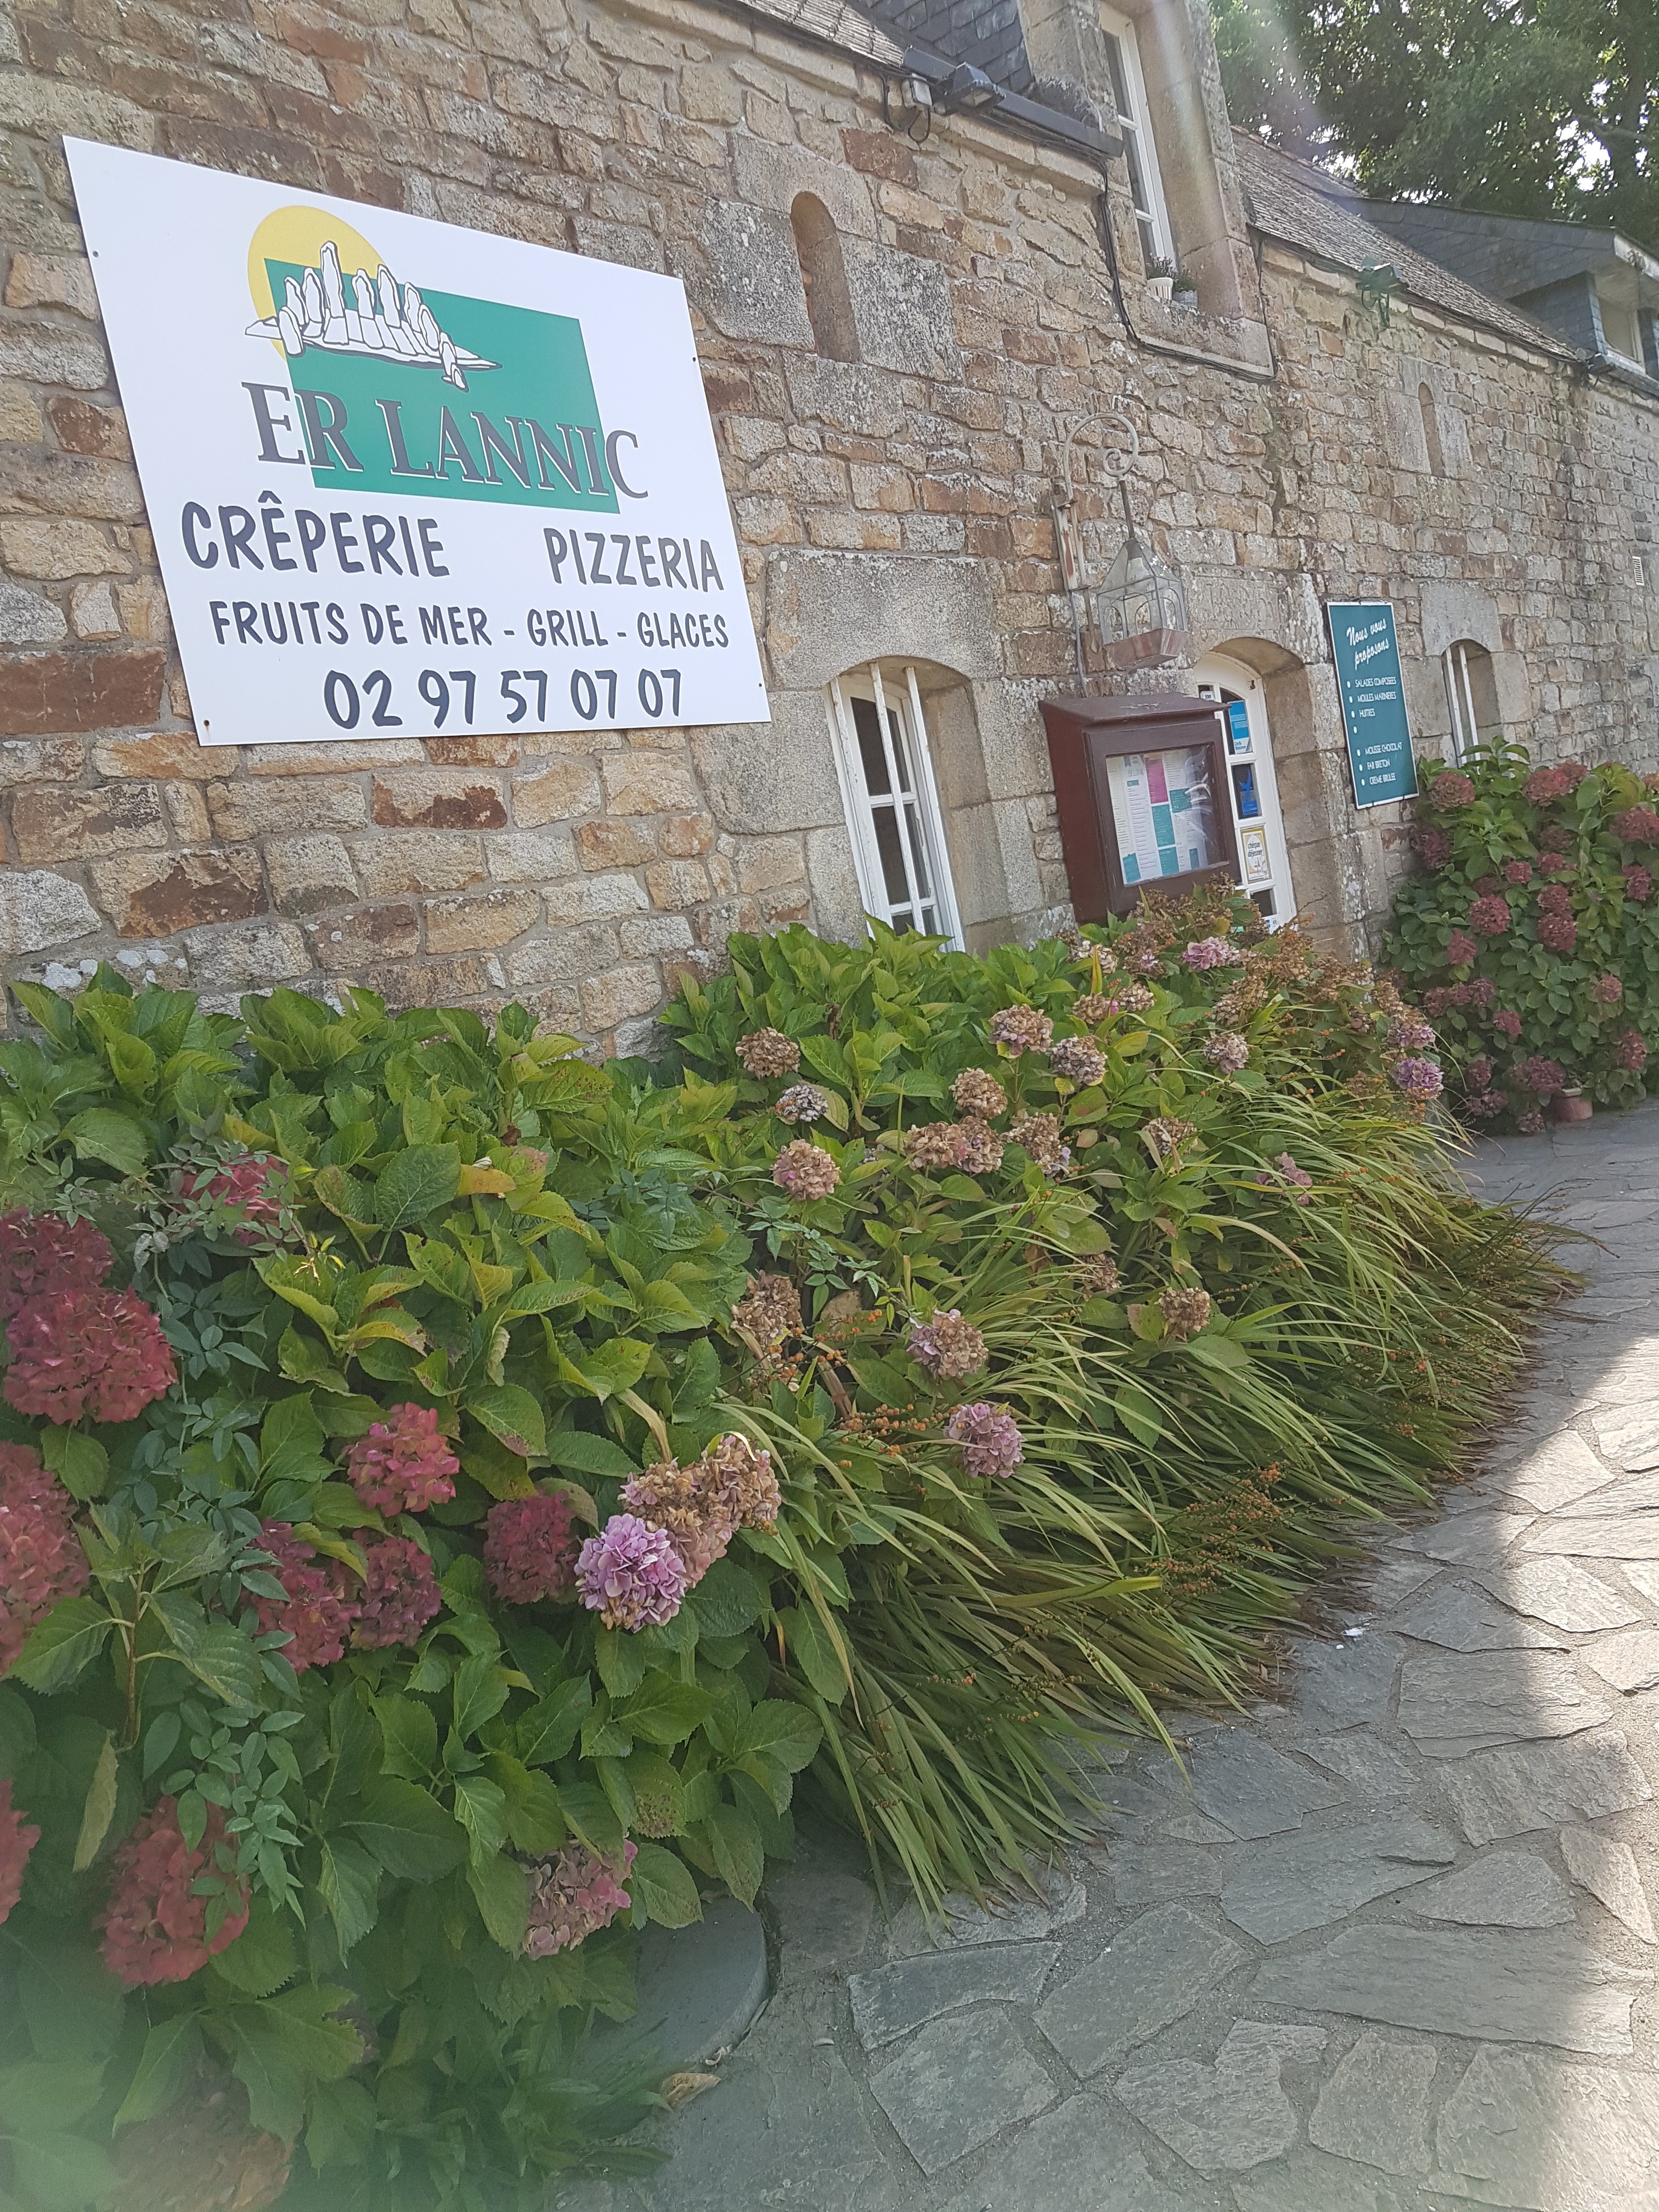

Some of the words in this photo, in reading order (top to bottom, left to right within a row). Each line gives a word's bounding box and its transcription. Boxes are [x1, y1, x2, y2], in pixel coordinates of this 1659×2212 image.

[241, 382, 364, 473] ER
[375, 399, 649, 499] LANNIC
[182, 490, 450, 577] CRÊPERIE
[543, 528, 724, 592] PIZZERIA
[209, 601, 349, 645] FRUITS
[360, 603, 408, 645] DE
[418, 605, 492, 646] MER
[527, 608, 609, 647] GRILL
[637, 612, 729, 648] GLACES
[1346, 627, 1368, 646] Nous
[1370, 618, 1387, 635] vous
[1355, 637, 1390, 671] proposons
[324, 670, 403, 730] 02
[418, 669, 476, 729] 97
[500, 670, 549, 724] 57
[570, 669, 618, 721] 07
[638, 668, 682, 718] 07
[1355, 678, 1374, 688] SALADES
[1357, 693, 1374, 703] MOULES
[1365, 745, 1382, 755] MOUSSE
[1382, 742, 1402, 753] CHOCOLAT
[1367, 761, 1375, 770] FAR
[1375, 759, 1391, 769] BRETON
